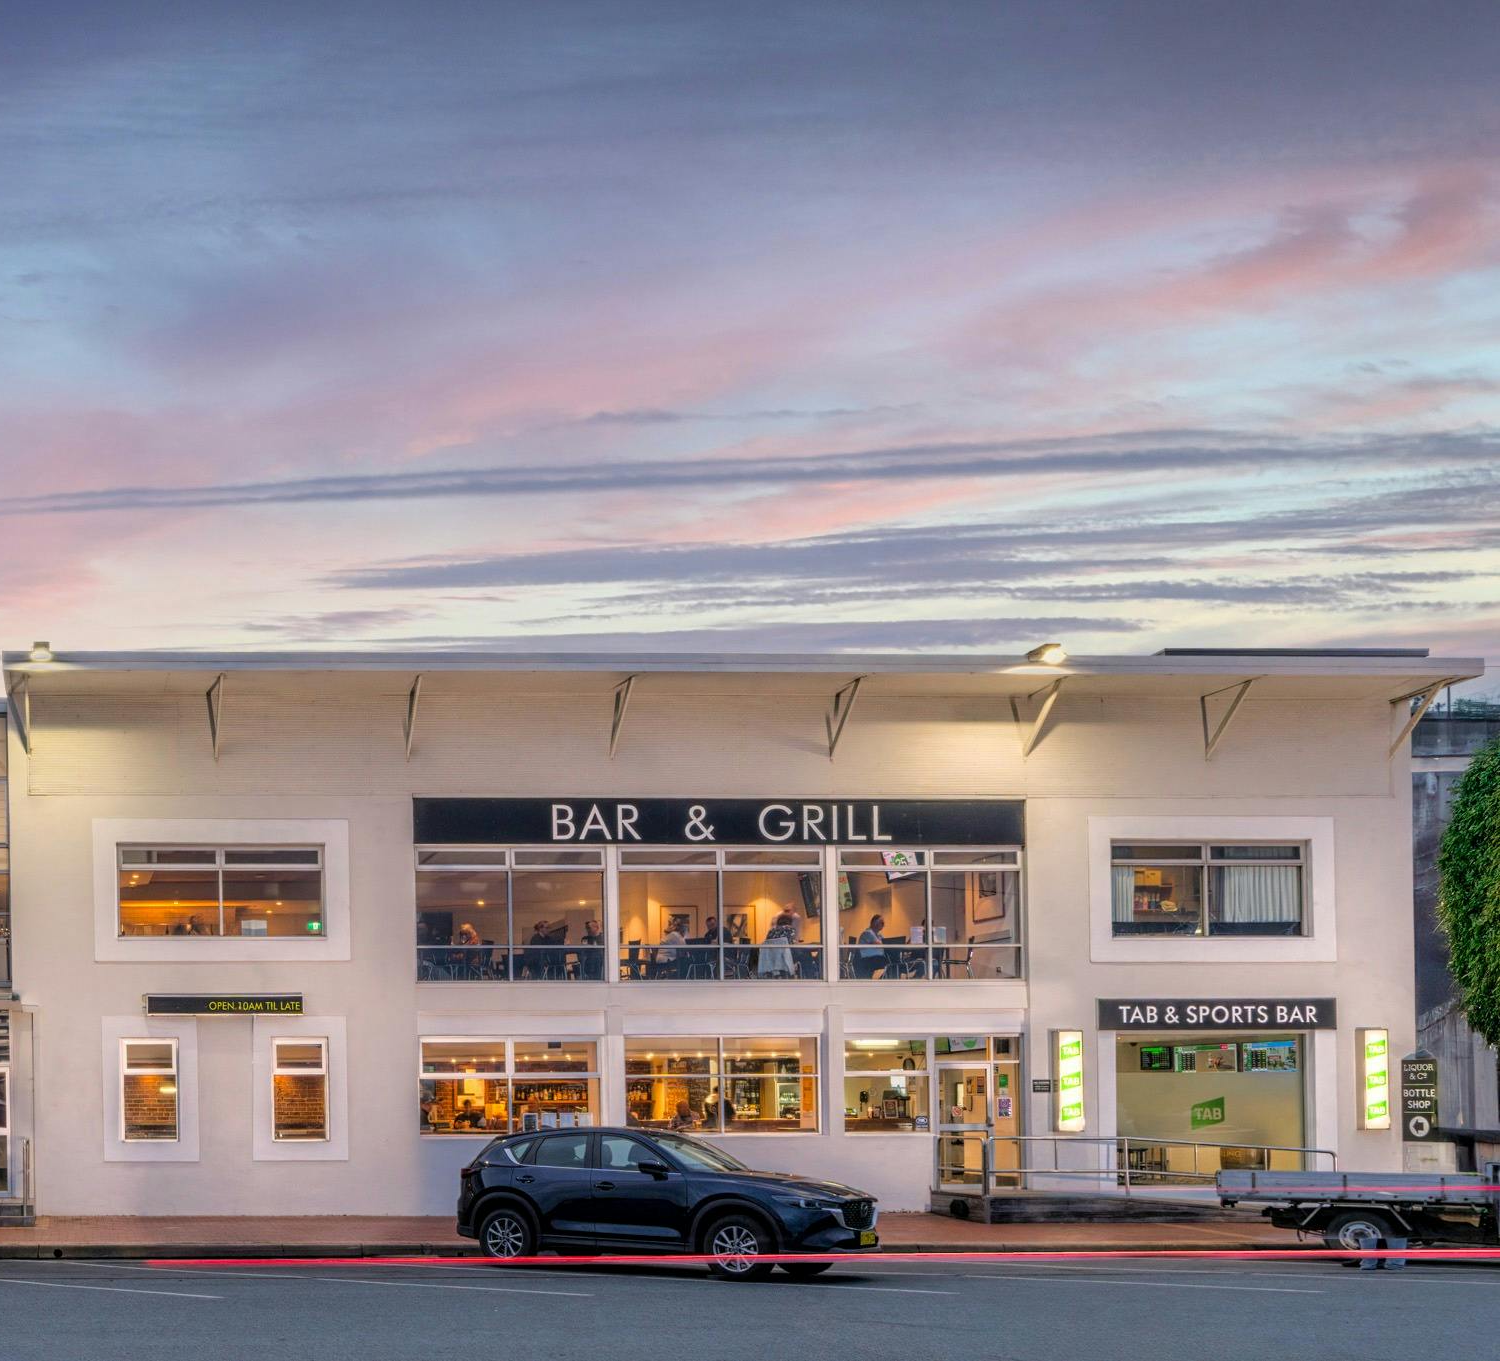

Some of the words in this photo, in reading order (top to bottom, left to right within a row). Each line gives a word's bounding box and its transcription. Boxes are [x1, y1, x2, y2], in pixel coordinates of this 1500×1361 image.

[552, 804, 643, 841] BAR
[684, 805, 716, 841] &
[758, 804, 893, 841] GRILL
[208, 1001, 235, 1011] OPEN
[238, 1001, 263, 1011] 10AM
[265, 1001, 278, 1011] TIL
[280, 1001, 301, 1011] LATE
[1118, 1006, 1158, 1024] TAB
[1164, 1006, 1179, 1024] &
[1186, 1005, 1268, 1024] SPORTS
[1276, 1006, 1318, 1023] BAR
[1403, 1063, 1434, 1072] LIQUOR
[1409, 1073, 1416, 1081] &
[1403, 1089, 1436, 1098] BOTTLE
[1407, 1100, 1431, 1109] SHOP
[1194, 1107, 1222, 1121] TAB
